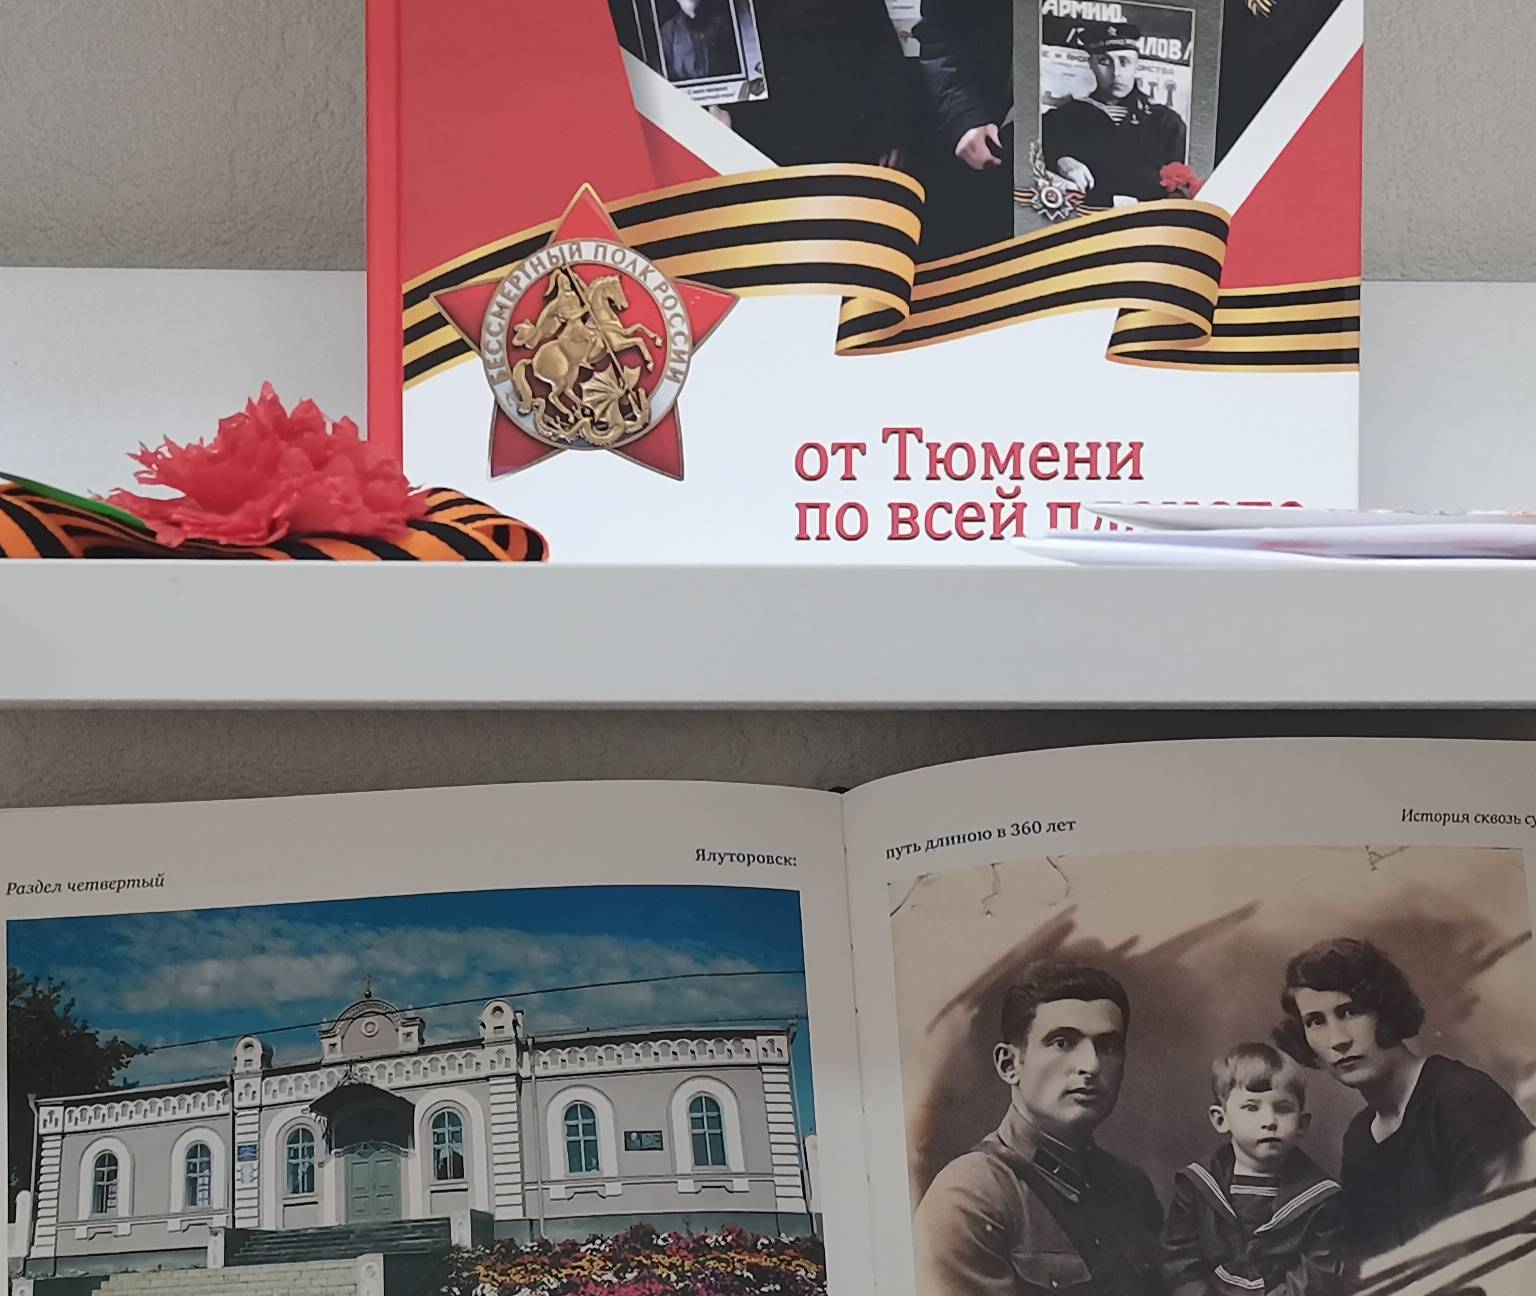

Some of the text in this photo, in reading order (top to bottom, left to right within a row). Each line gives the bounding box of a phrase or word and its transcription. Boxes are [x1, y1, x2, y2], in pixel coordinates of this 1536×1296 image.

[593, 245, 657, 283] ПОЛК
[487, 243, 583, 385] БЕССМЕРТНЫЙ
[653, 283, 690, 384] РОССИИ
[794, 427, 1145, 481] от Тюмени
[795, 501, 868, 541] по
[888, 486, 1028, 541] всей
[1401, 808, 1470, 826] История
[1474, 812, 1522, 825] сквозь
[695, 848, 797, 867] Ялуторовск:
[885, 818, 1077, 861] путь длиною в 360 лет
[5, 872, 166, 896] Раздел четвертый
